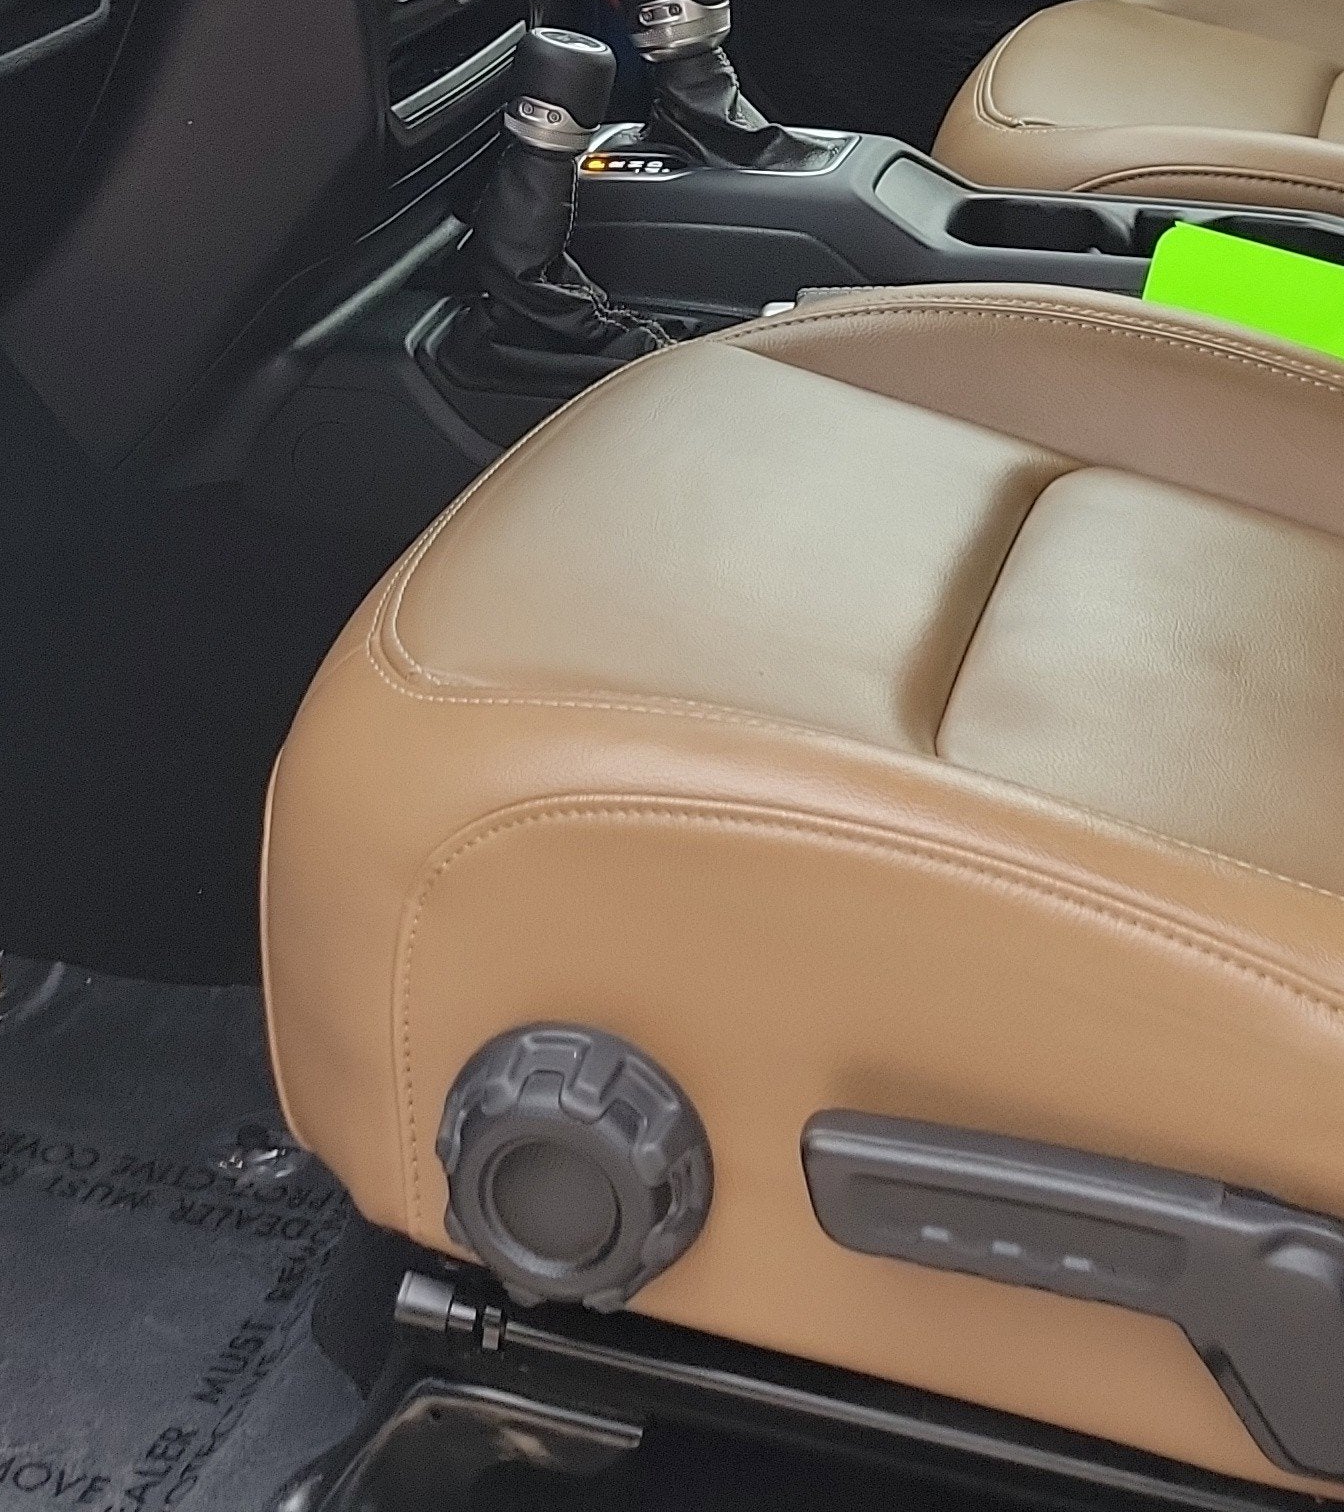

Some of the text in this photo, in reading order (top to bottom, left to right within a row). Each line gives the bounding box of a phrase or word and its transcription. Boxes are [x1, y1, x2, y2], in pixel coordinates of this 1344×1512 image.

[43, 1174, 155, 1211] MUST
[169, 1196, 311, 1241] DEALER
[191, 1317, 274, 1406] MUST
